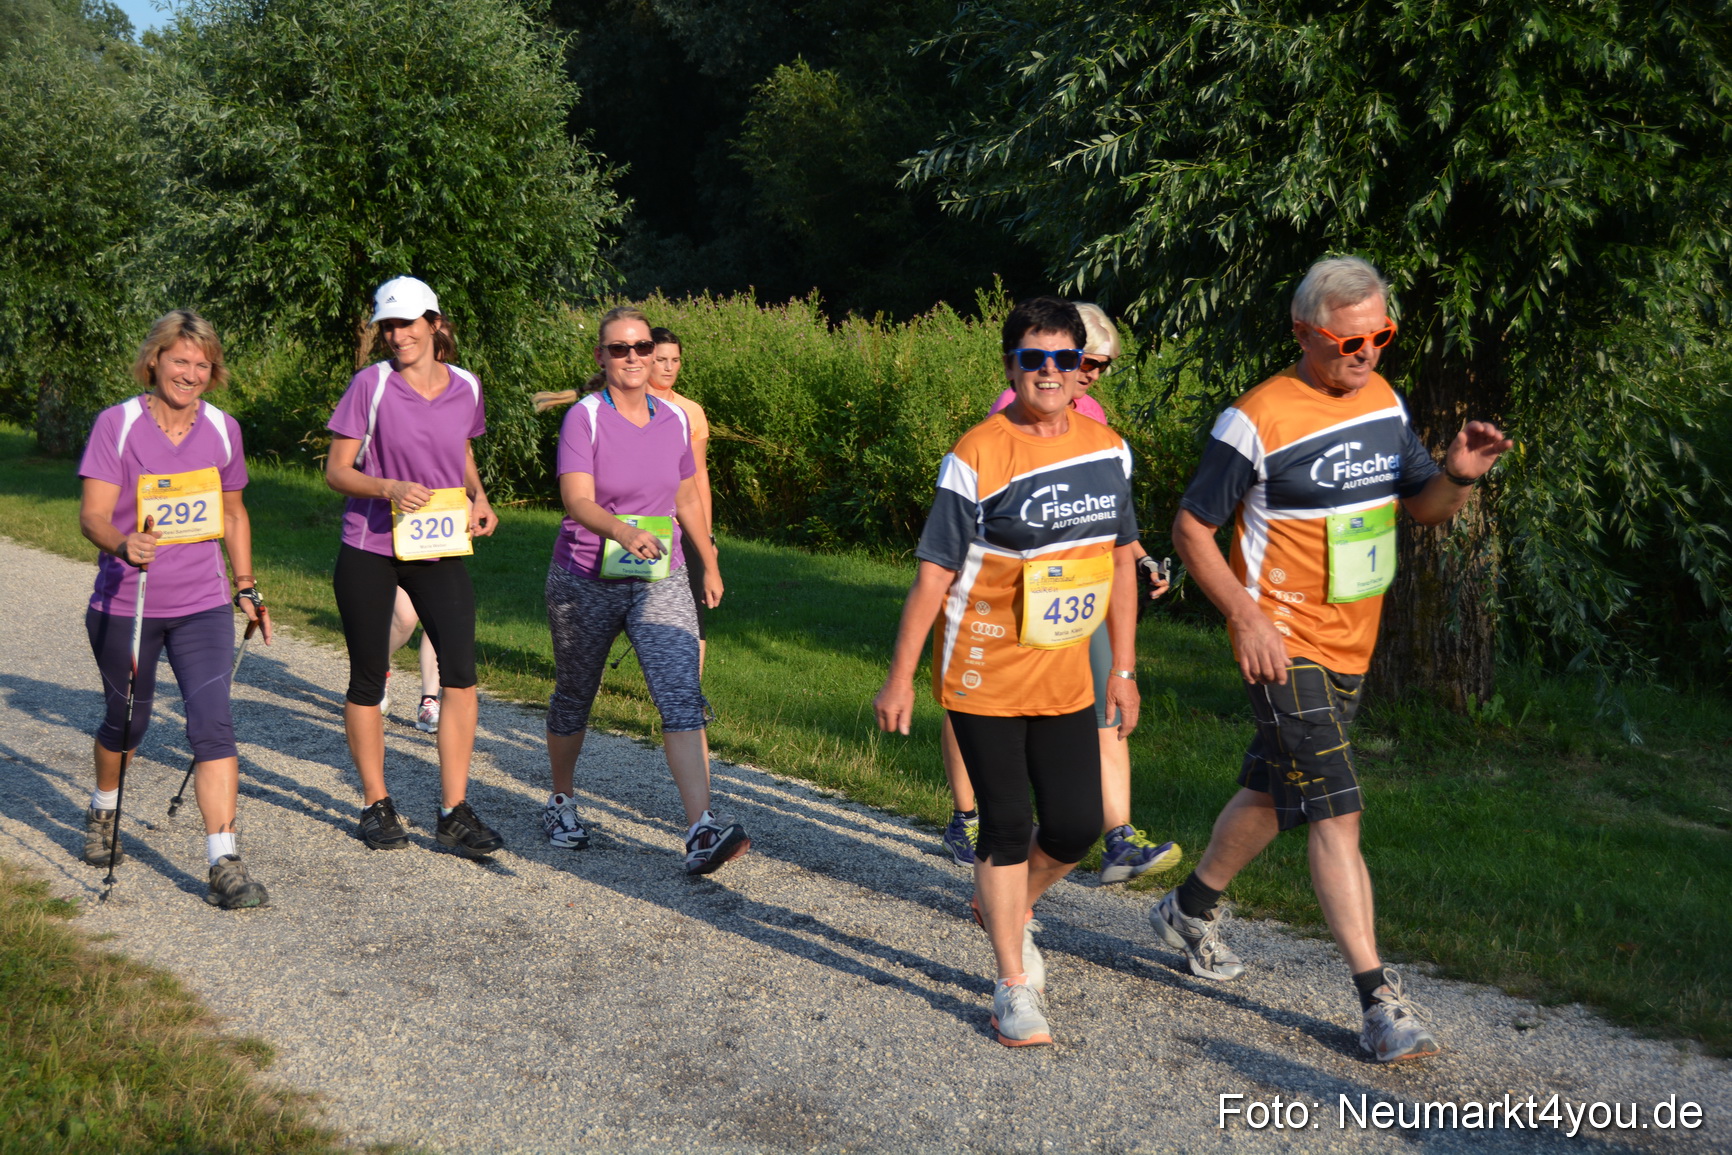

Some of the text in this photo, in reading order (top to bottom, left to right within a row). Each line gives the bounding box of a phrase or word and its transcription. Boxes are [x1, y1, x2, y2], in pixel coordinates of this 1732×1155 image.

[157, 500, 207, 526] 292
[1041, 494, 1116, 521] Fischer
[1051, 510, 1117, 530] AUTOMOBILE
[410, 517, 454, 540] 320
[1367, 545, 1376, 572] 1
[1043, 593, 1096, 625] 438
